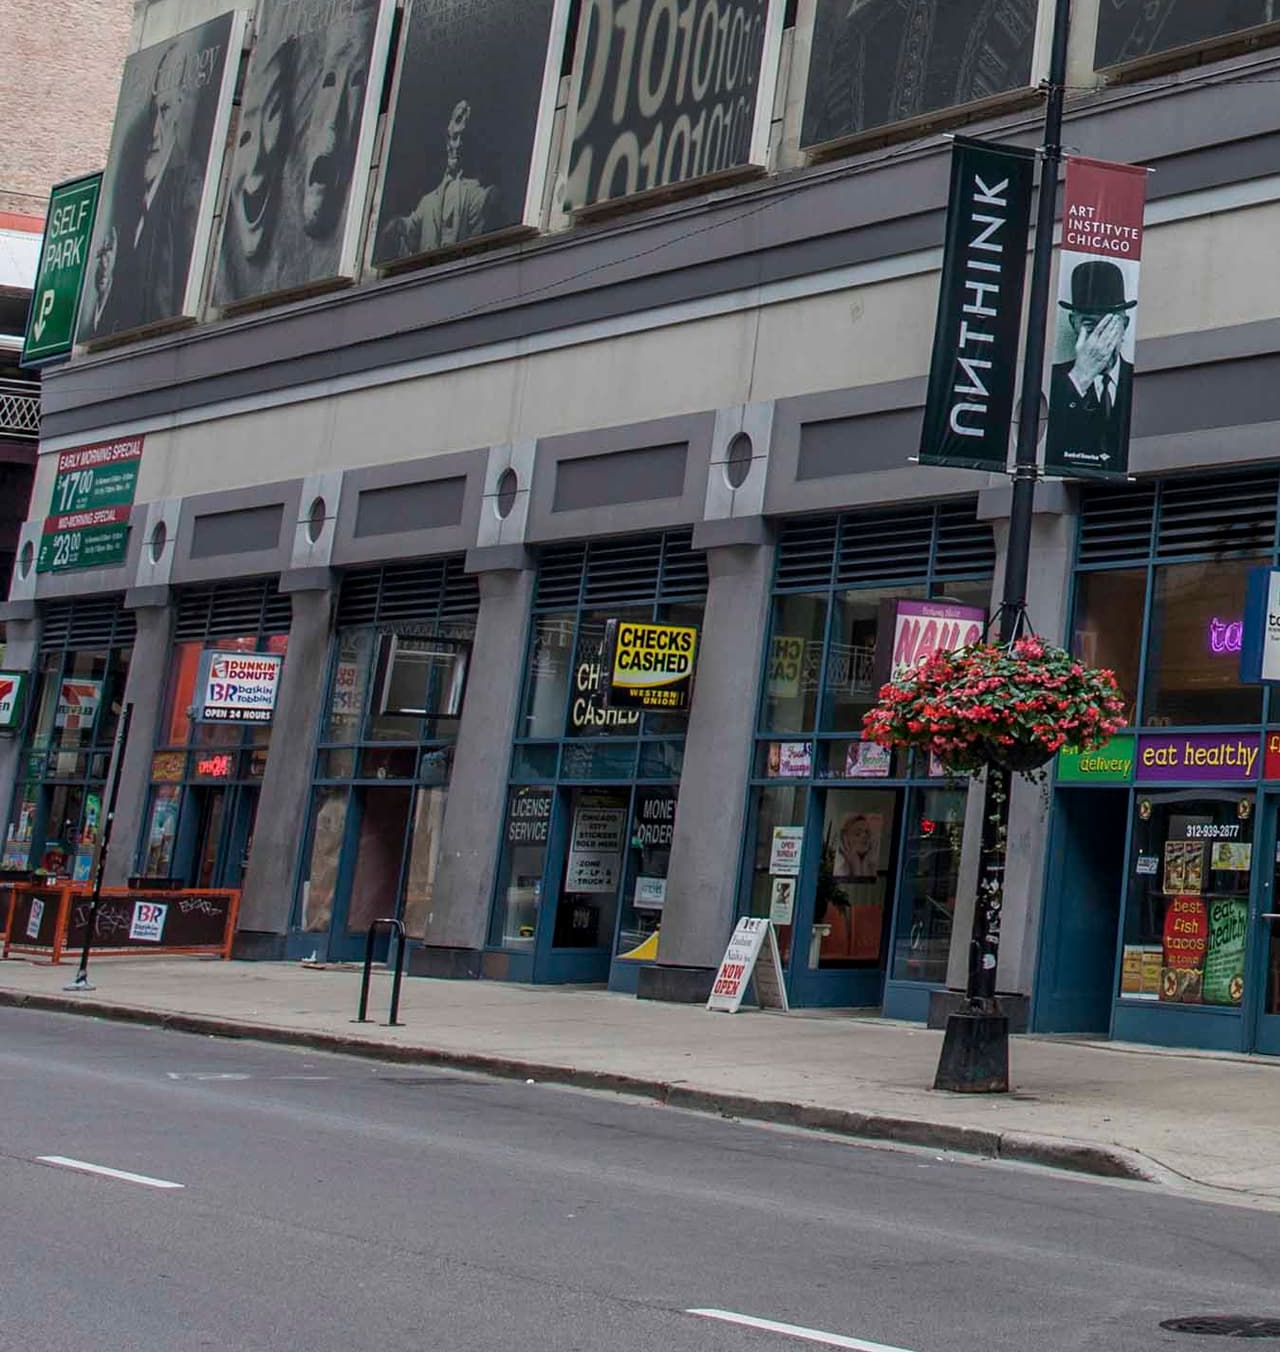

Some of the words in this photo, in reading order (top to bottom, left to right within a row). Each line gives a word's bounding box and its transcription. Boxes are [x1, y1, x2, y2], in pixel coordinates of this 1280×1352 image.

[51, 200, 90, 238] SELF
[1069, 204, 1095, 218] ART
[1068, 218, 1138, 240] INSTITVTE
[1067, 233, 1130, 252] CHICAGO
[44, 235, 85, 273] PARK
[60, 454, 81, 471] EARLY
[80, 446, 112, 468] MORNING
[112, 440, 141, 461] SPECIAL
[620, 628, 691, 652] CHECKS
[1210, 617, 1244, 652] ta
[230, 661, 279, 672] DUNKIN'
[618, 651, 688, 673] CASHED
[229, 670, 275, 681] DONUTS
[210, 683, 237, 702] BR
[237, 694, 272, 704] robbins
[238, 684, 273, 695] baskin
[630, 689, 677, 698] WESTERN
[643, 697, 676, 706] UNION
[205, 710, 227, 719] OPEN
[230, 710, 241, 719] 24
[242, 710, 271, 720] HOURS
[1080, 756, 1131, 777] delivery
[1143, 743, 1178, 766] eat
[1184, 741, 1258, 776] healthy
[511, 798, 550, 817] LICENSE
[643, 799, 678, 819] MONE
[509, 822, 547, 841] SERVICE
[637, 824, 674, 844] ORDER
[138, 905, 163, 924] BR
[1174, 899, 1203, 914] best
[1213, 900, 1235, 922] eat
[1174, 918, 1199, 934] fish
[1209, 910, 1248, 950] healthy
[1167, 936, 1205, 950] tacos
[720, 963, 745, 979] NOW
[714, 979, 740, 996] OPEN
